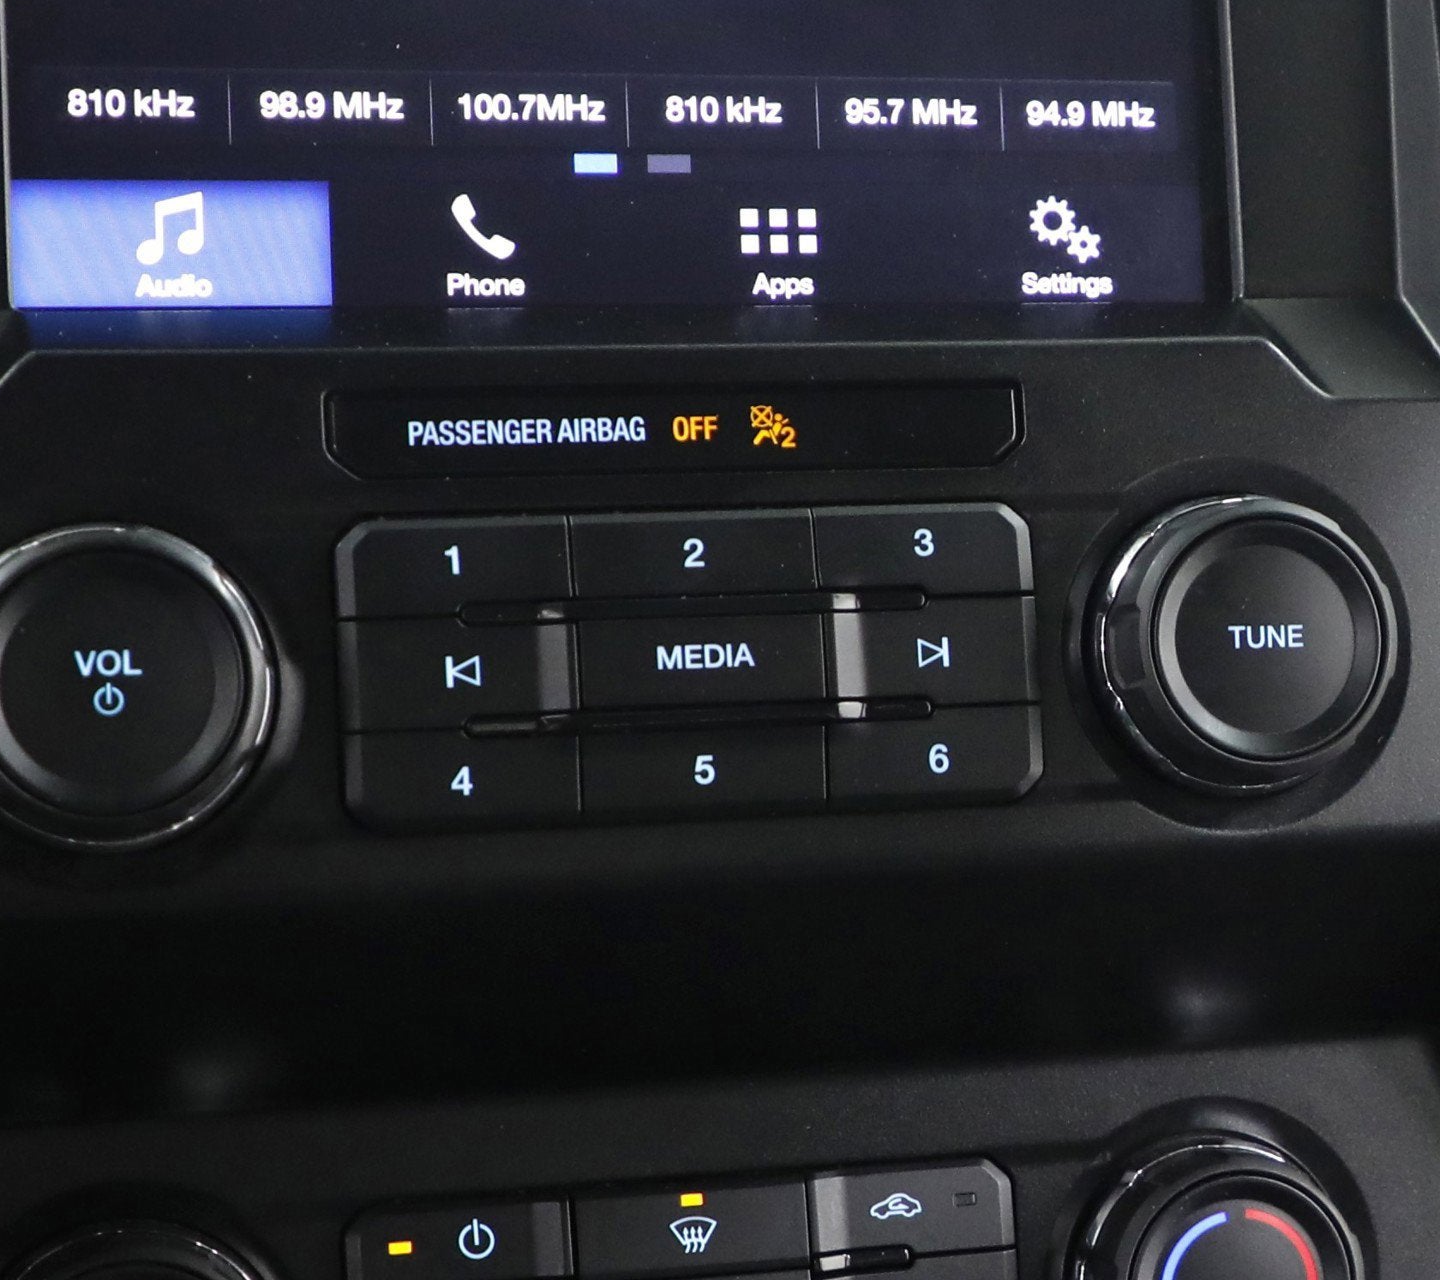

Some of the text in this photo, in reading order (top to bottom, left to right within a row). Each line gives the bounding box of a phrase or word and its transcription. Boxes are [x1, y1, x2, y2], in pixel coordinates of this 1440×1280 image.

[67, 88, 196, 119] 810 kHz
[259, 90, 405, 121] 98.9 MHz
[457, 92, 606, 124] 100.7MHz
[665, 95, 783, 125] 810 kHz
[844, 97, 978, 128] 95.7 MHz
[1025, 99, 1157, 131] 94.9 MHz
[135, 272, 213, 297] Audio
[446, 272, 526, 297] Phone
[751, 272, 815, 302] Apps
[1021, 271, 1114, 300] Settings
[407, 418, 553, 447] PASSENGER
[556, 415, 647, 444] AIRBAG
[672, 415, 718, 442] OFF
[683, 537, 706, 568] 2
[913, 528, 935, 557] 3
[444, 545, 461, 575] 1
[1227, 624, 1305, 649] TUNE
[74, 649, 143, 677] VOL
[656, 642, 756, 671] MEDIA
[694, 754, 716, 786] 5
[928, 743, 950, 774] 6
[450, 765, 474, 796] 4
